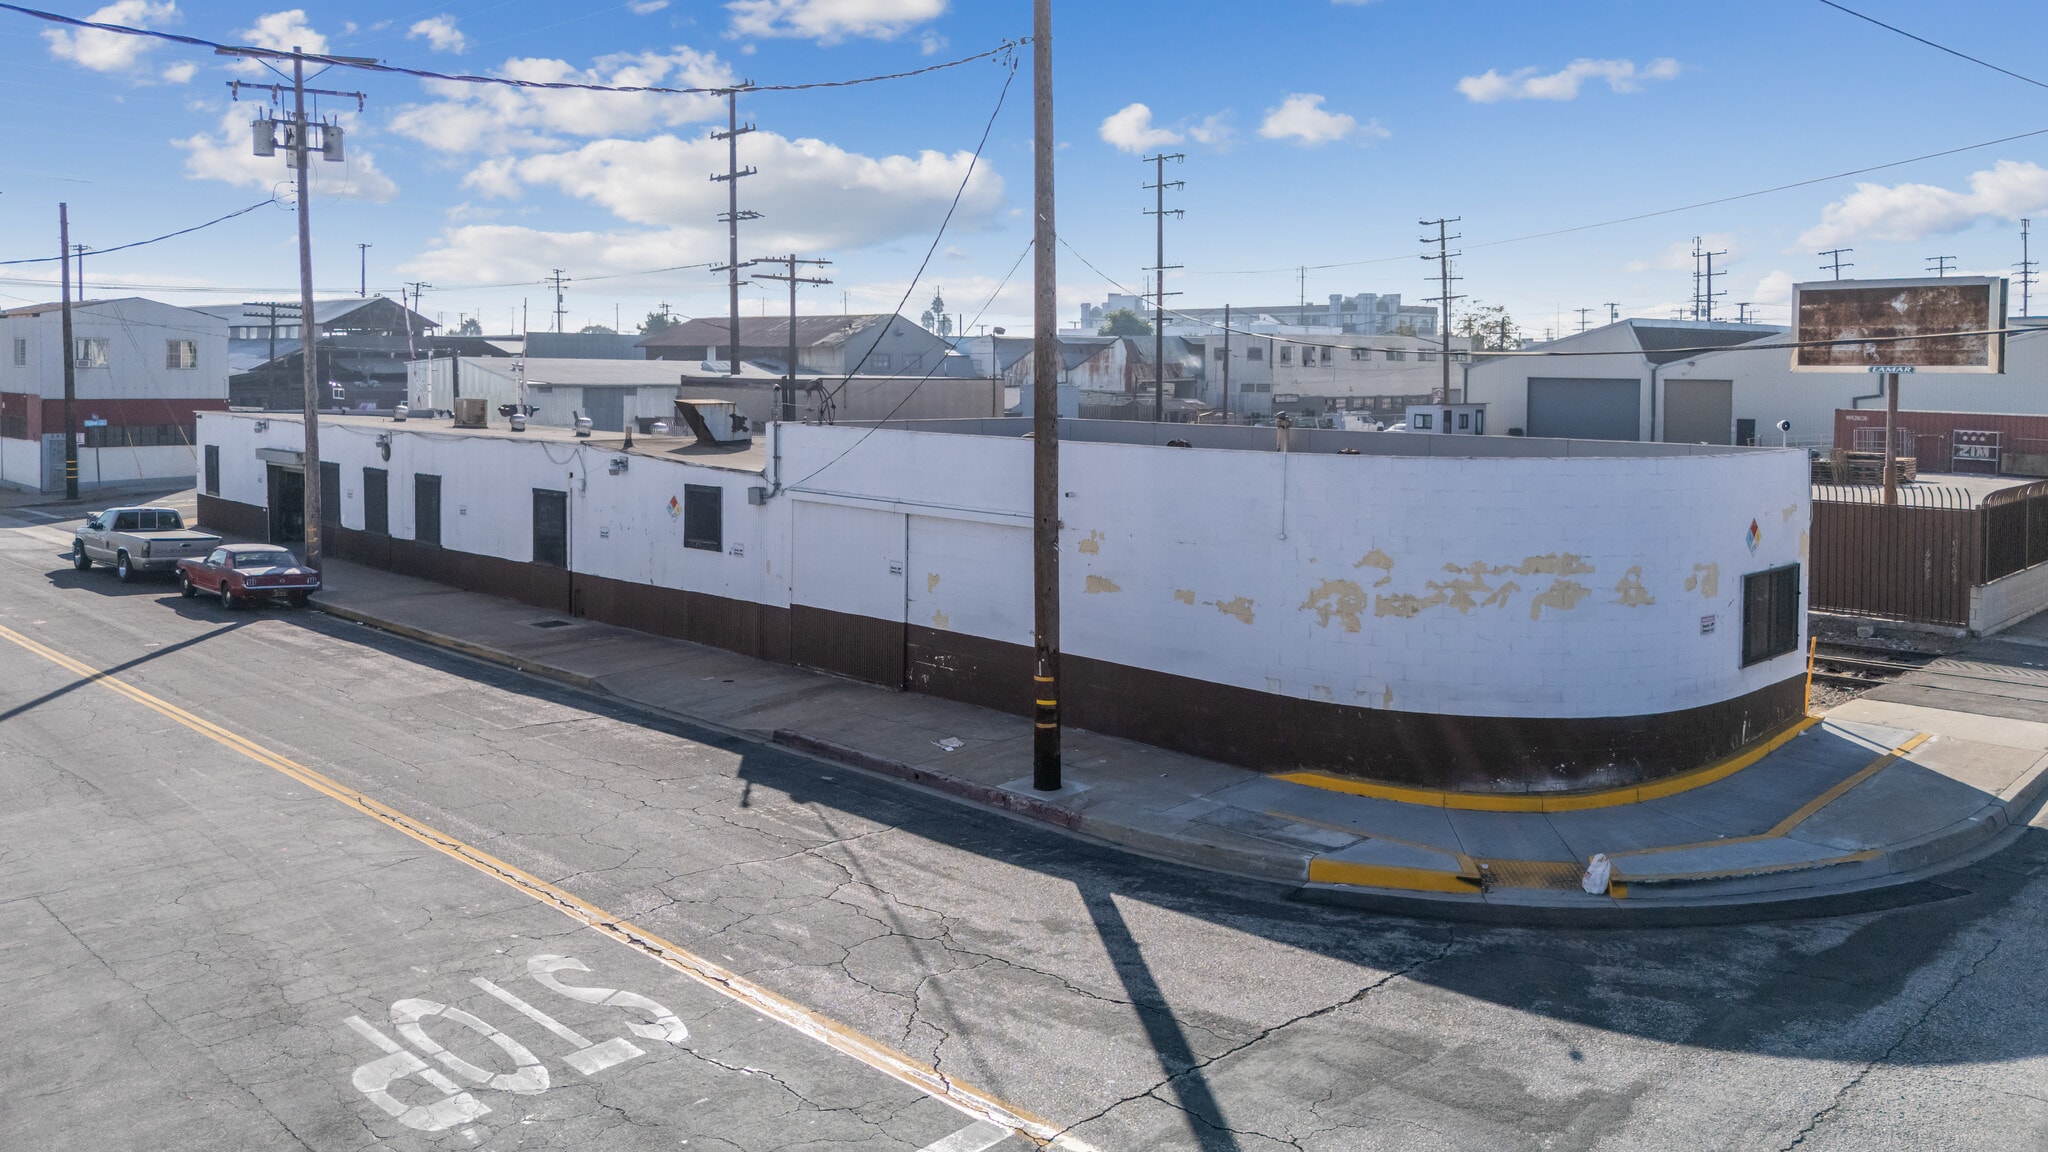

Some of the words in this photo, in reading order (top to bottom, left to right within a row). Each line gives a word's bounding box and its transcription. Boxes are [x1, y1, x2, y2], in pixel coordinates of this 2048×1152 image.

[1871, 366, 1913, 374] LAMAR
[1959, 445, 1990, 457] ZIM
[343, 954, 691, 1131] STOP
